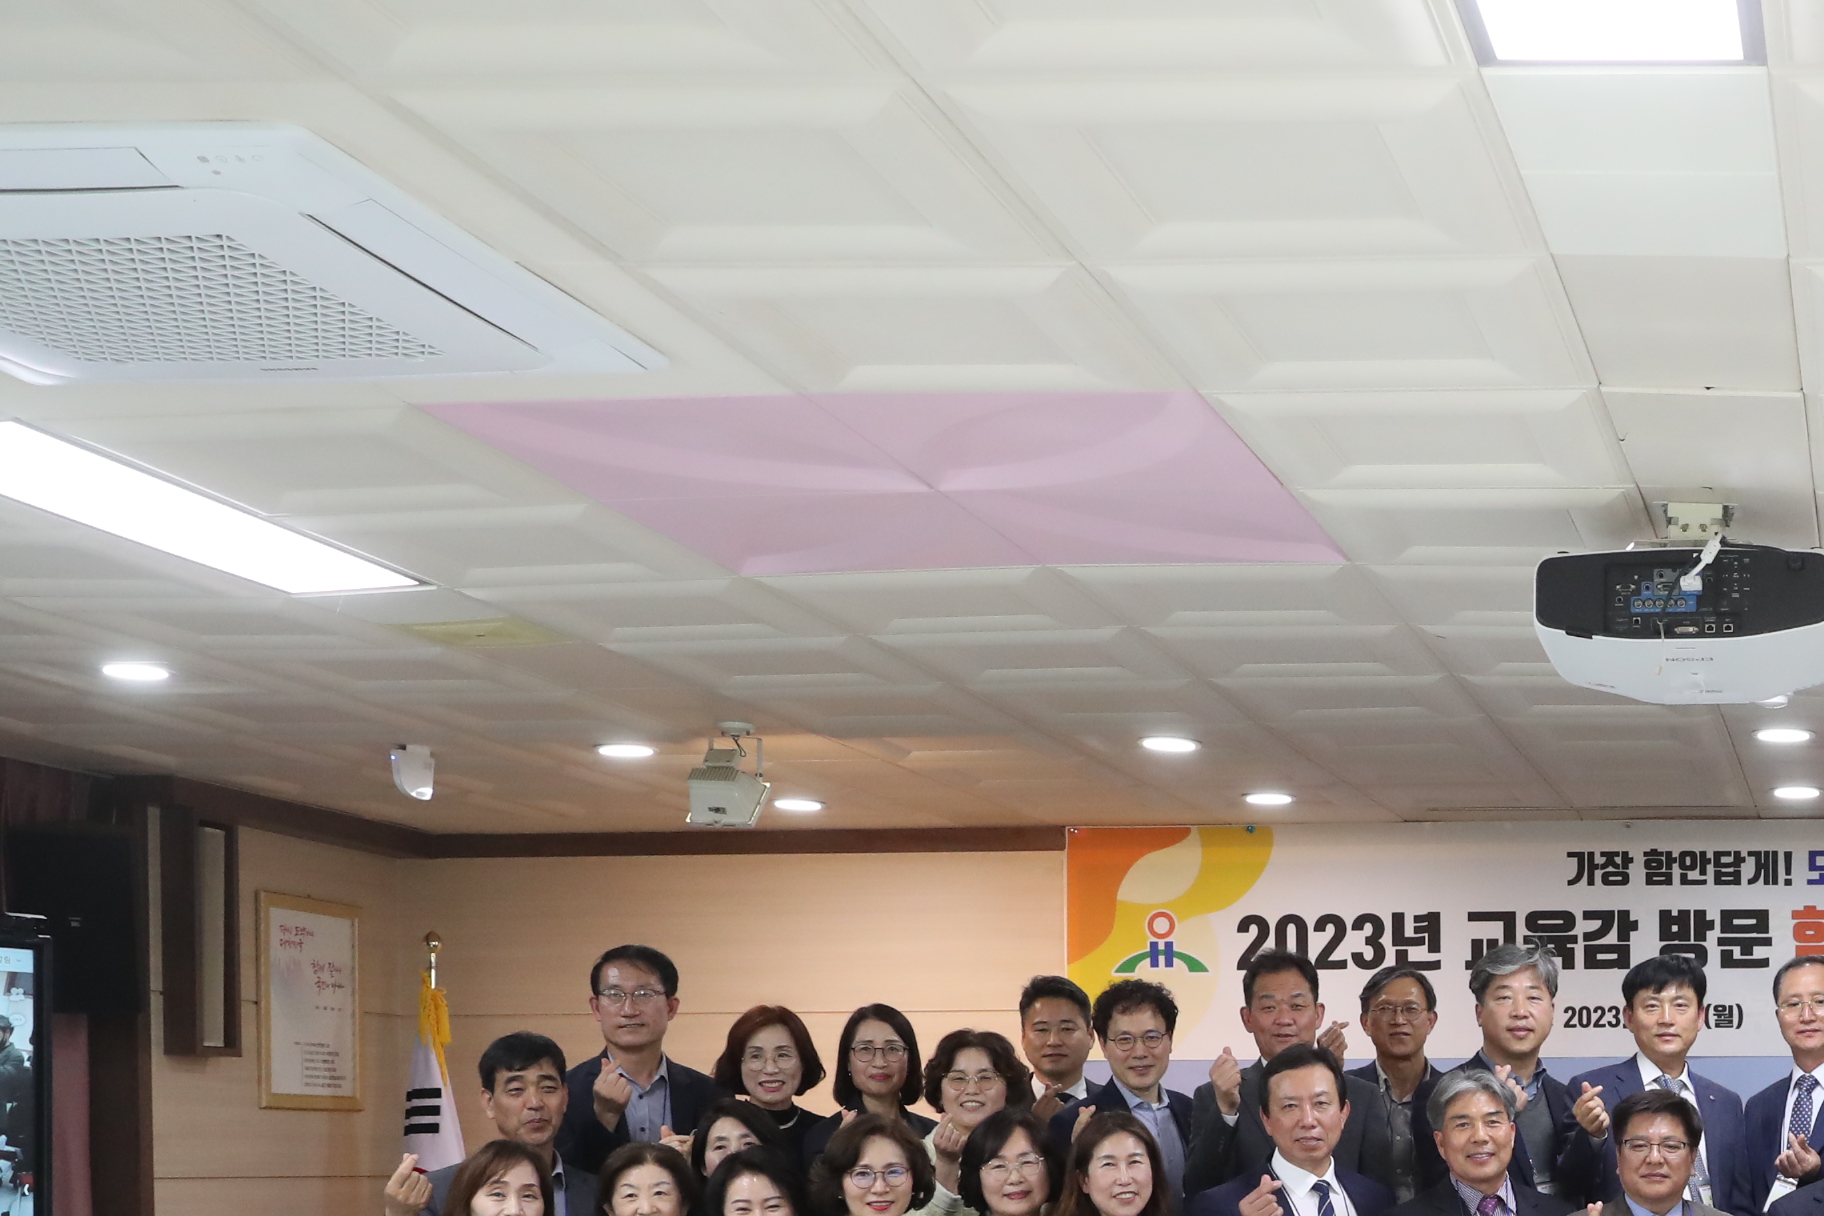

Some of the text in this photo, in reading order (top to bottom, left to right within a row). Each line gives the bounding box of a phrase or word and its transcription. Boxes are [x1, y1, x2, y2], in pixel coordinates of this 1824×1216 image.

[1566, 850, 1634, 887] 가장
[1643, 848, 1793, 887] 함안답게!
[1236, 911, 1442, 971] 2023년
[1465, 910, 1639, 971] 교육감
[1658, 908, 1773, 970] 방문
